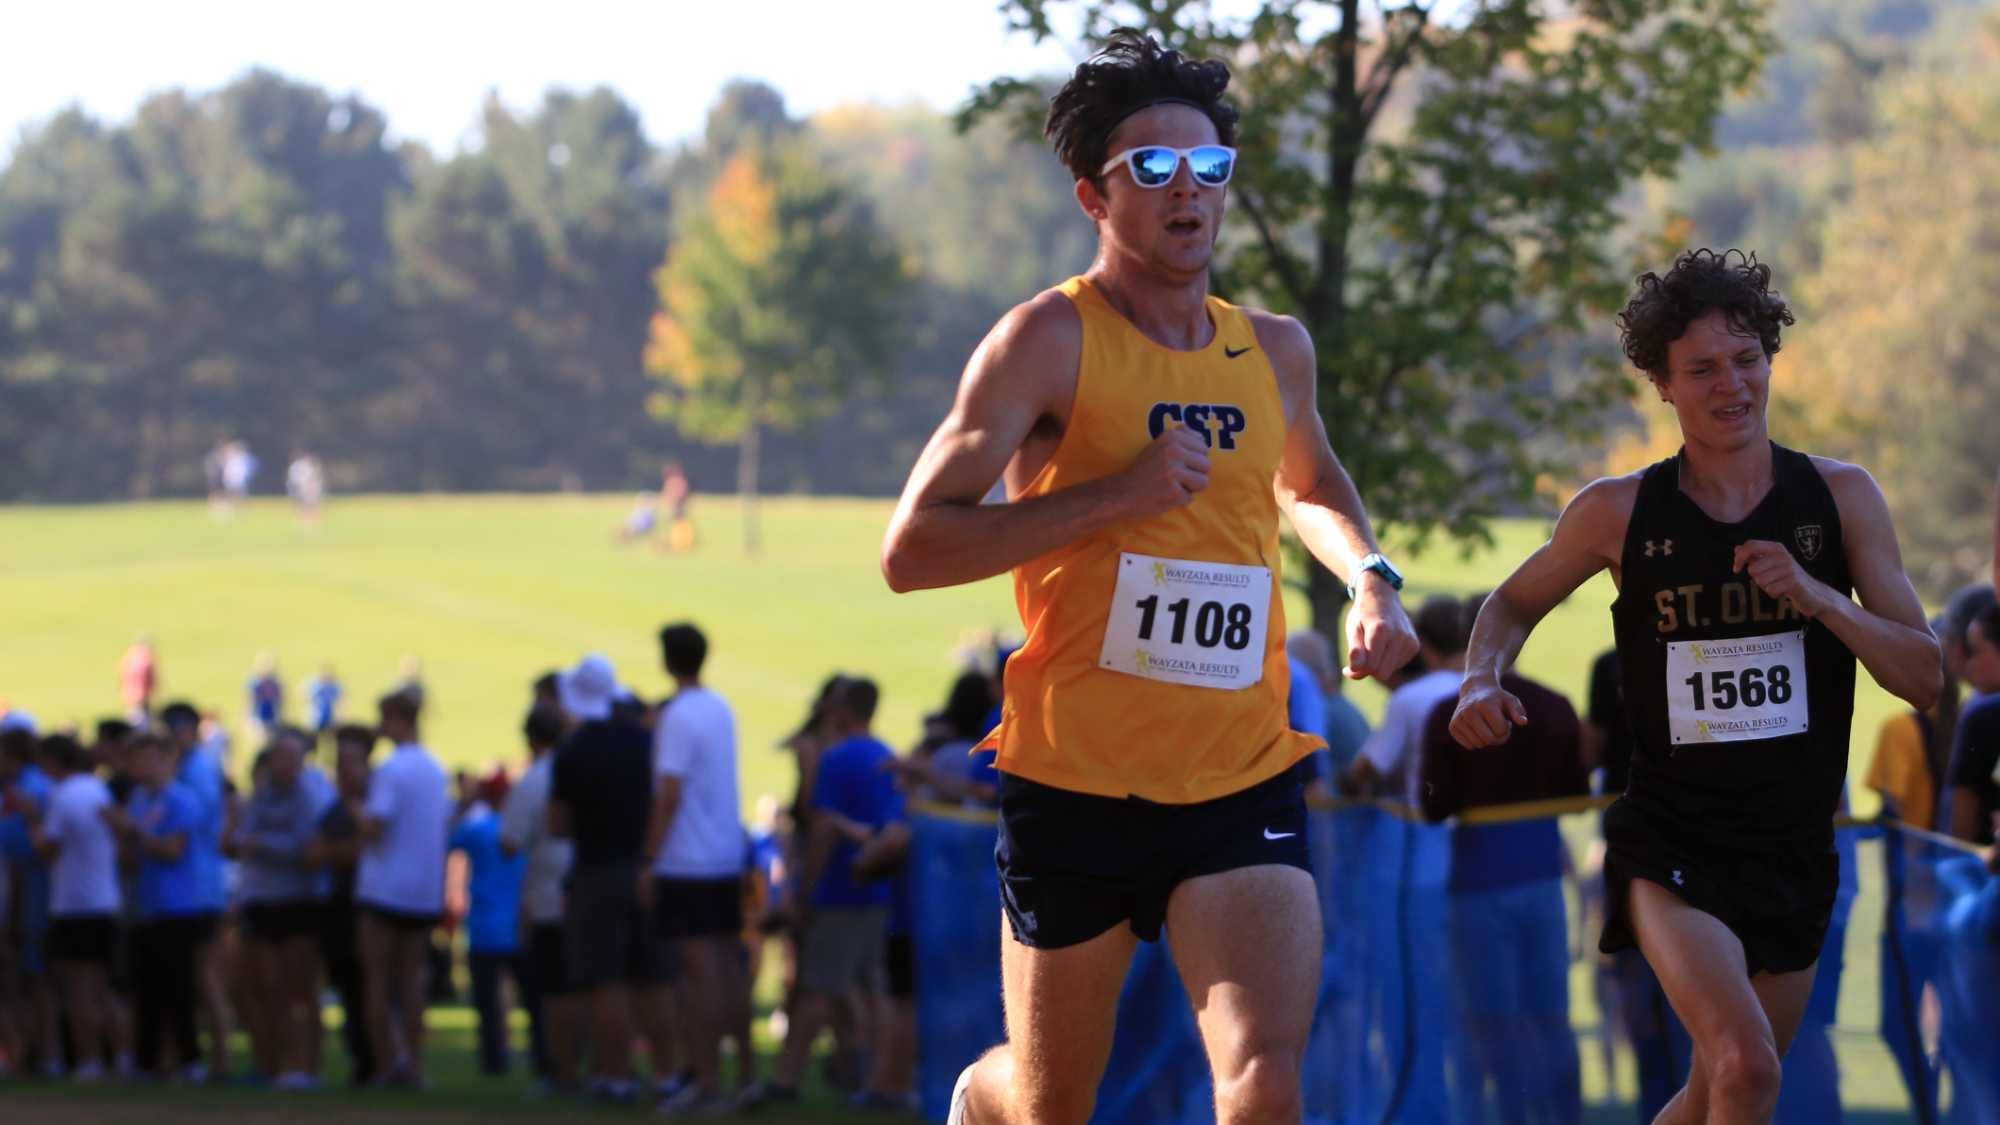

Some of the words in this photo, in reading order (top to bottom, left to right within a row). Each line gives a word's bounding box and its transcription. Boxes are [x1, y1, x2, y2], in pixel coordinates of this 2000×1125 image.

[1147, 401, 1247, 451] CSP
[1165, 568, 1210, 581] WAYZATA
[1213, 573, 1250, 584] RESULTS
[1135, 594, 1252, 651] 1108
[1654, 584, 1711, 633] ST.
[1721, 579, 1810, 624] OLA
[1702, 645, 1744, 656] WAYZATA
[1746, 641, 1783, 653] RESULTS
[1148, 656, 1196, 671] WAYZATA
[1199, 662, 1240, 675] RESULTS
[1685, 664, 1792, 711] 1568
[1707, 720, 1750, 731] WAYZATA
[1752, 716, 1788, 727] RESULTS
